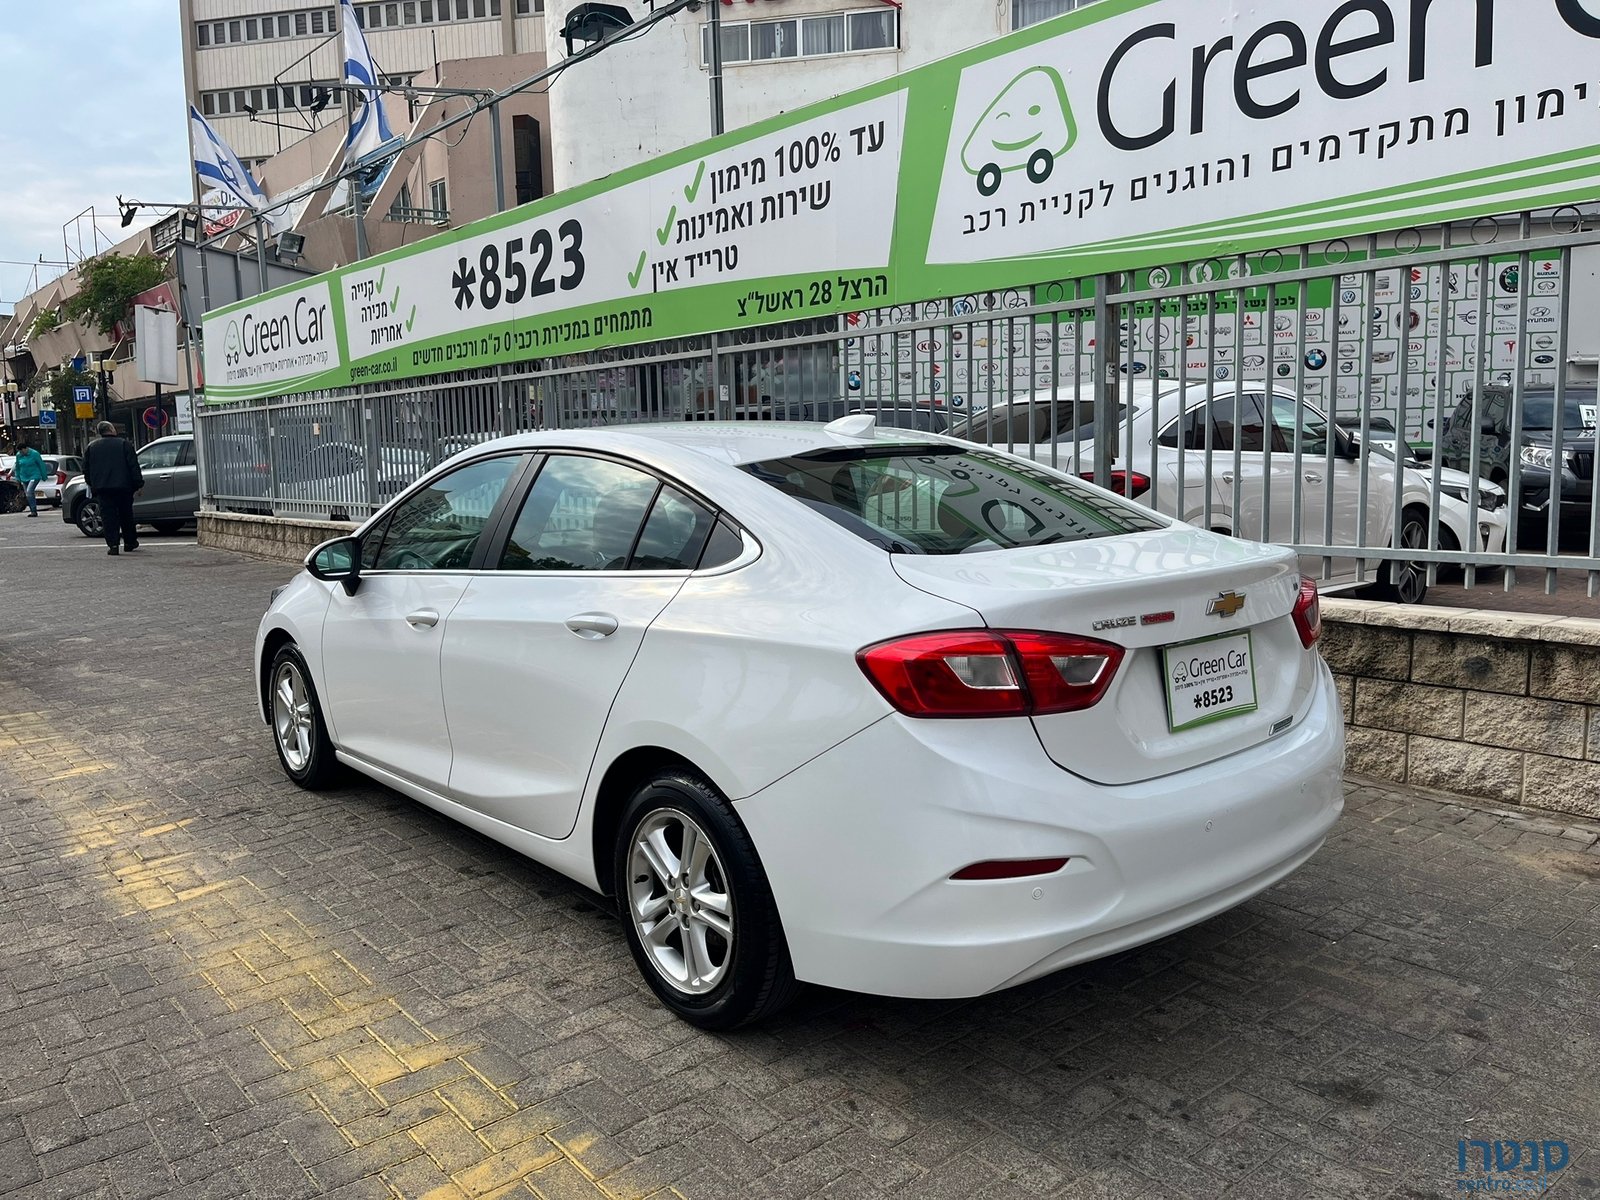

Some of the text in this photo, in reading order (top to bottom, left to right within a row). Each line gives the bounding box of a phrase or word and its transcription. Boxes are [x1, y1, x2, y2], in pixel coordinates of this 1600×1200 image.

[1097, 0, 1494, 151] Green
[710, 120, 885, 204] עד 100% מימון
[963, 82, 1600, 235] ימון מתקדמים והוגנים לקניית רכב
[676, 180, 831, 244] שירות ואמינות
[652, 244, 738, 293] טרייד אין
[351, 280, 374, 301] קנייה
[809, 280, 832, 306] 28
[838, 275, 888, 302] הרצל
[361, 301, 388, 323] מכירה
[594, 307, 653, 337] מתמחים
[242, 297, 326, 358] Green Car
[370, 323, 403, 346] אחריות
[513, 328, 539, 350] רכבי
[542, 320, 590, 345] במכירת
[446, 341, 478, 361] ורכבים
[504, 331, 511, 352] 0
[413, 346, 444, 366] חדשים
[350, 357, 398, 381] green-car.co.il
[1092, 616, 1137, 631] CRUZE
[1189, 649, 1247, 678] Green Car
